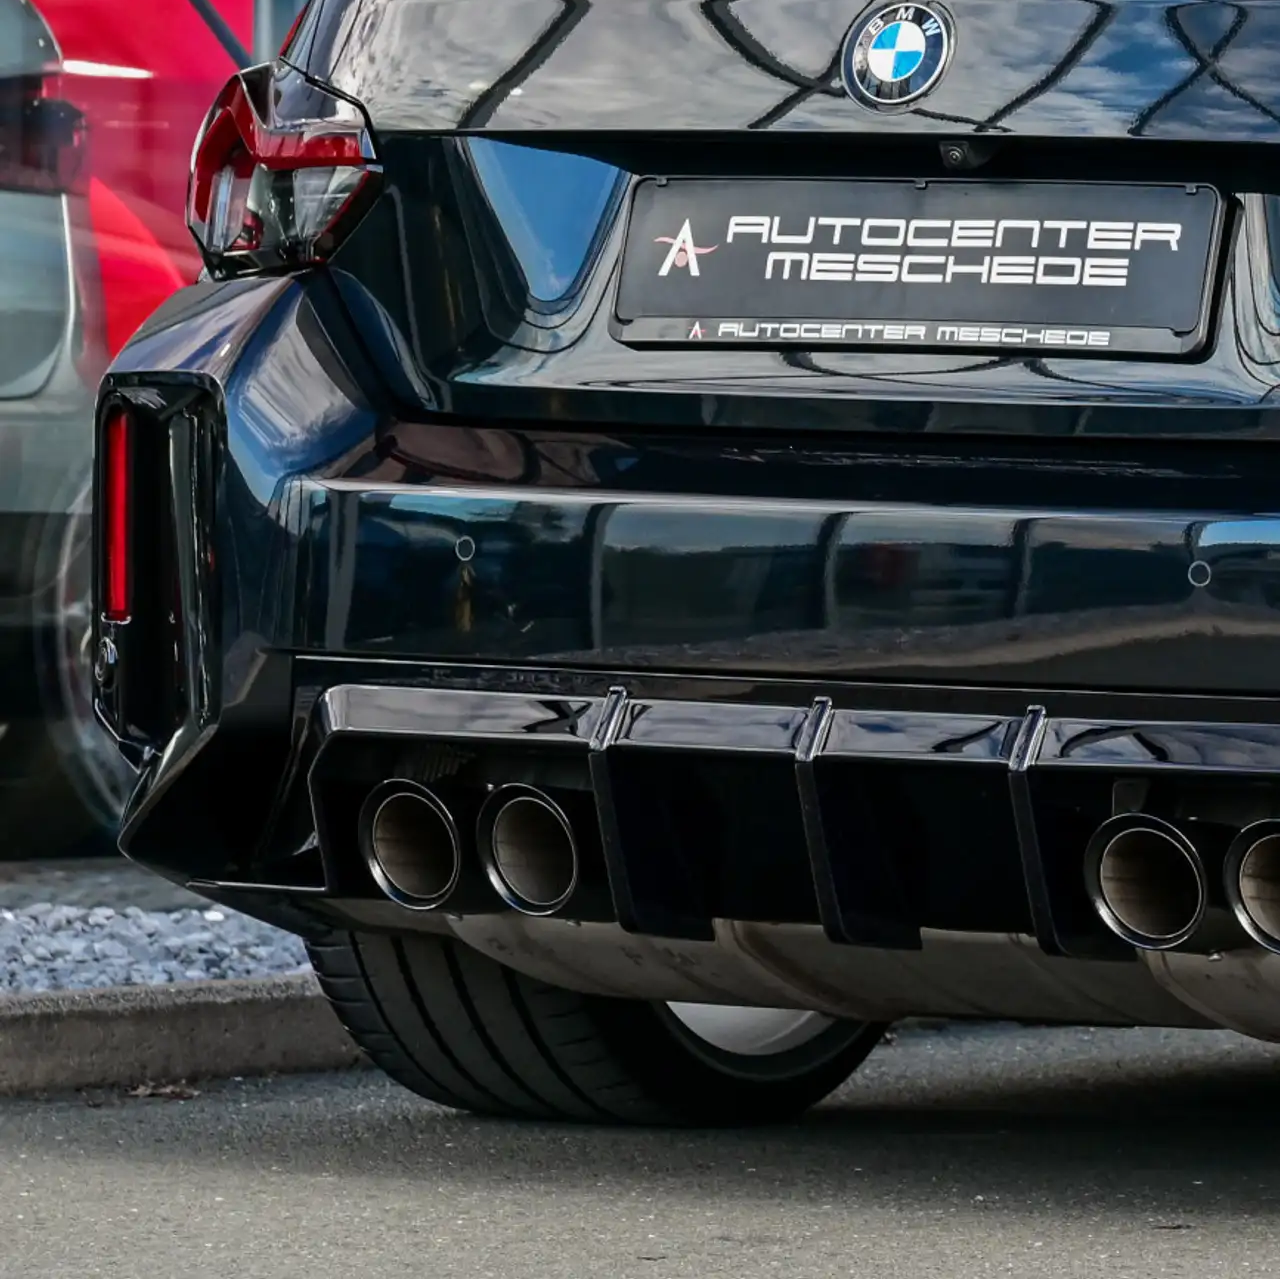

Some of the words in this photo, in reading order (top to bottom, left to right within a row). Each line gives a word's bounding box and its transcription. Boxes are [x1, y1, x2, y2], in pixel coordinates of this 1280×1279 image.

[868, 6, 942, 37] BMW
[726, 216, 1182, 251] AUTOCENTER
[764, 252, 1129, 286] MESCHEDE
[718, 322, 927, 341] AUTOCENTER
[937, 324, 1111, 346] MESCHEDE
